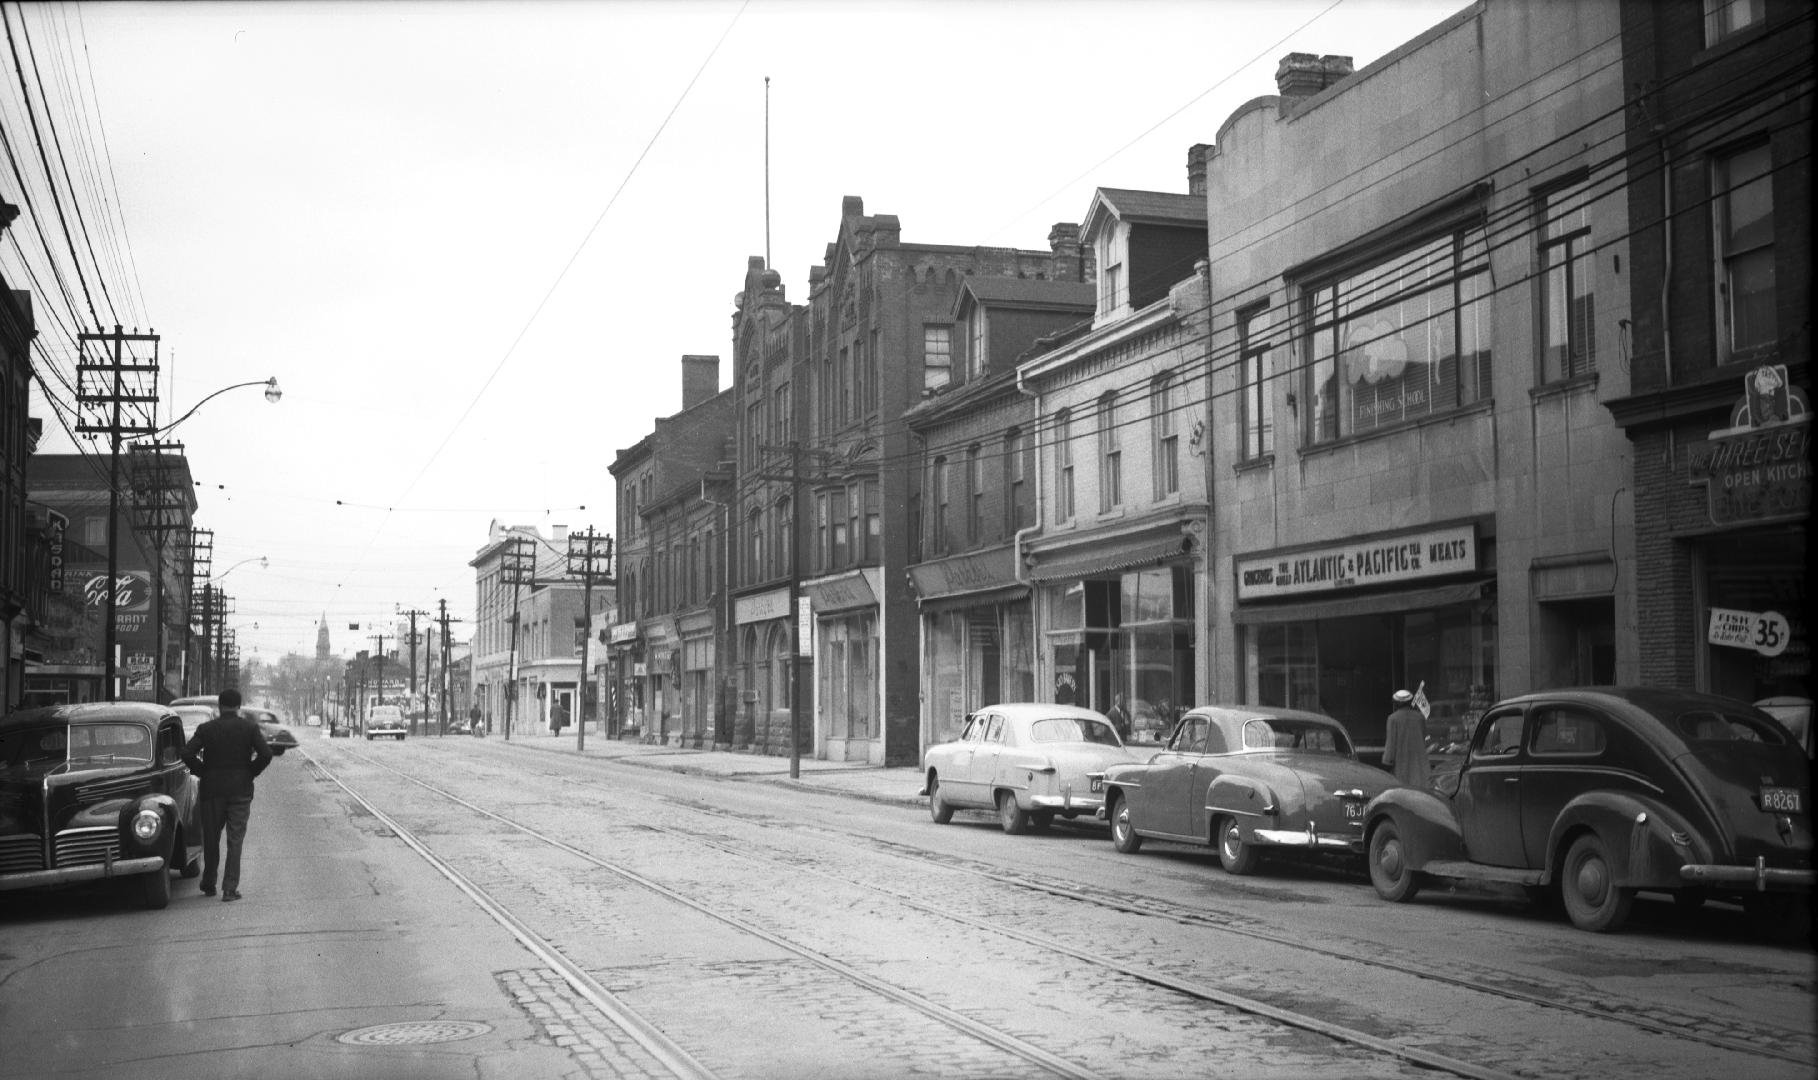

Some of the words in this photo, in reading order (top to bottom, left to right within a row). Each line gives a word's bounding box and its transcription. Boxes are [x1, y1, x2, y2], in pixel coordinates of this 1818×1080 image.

[1708, 437, 1769, 471] THREE
[1724, 469, 1760, 489] OPEN
[1293, 554, 1346, 585] ATLANTIC
[1347, 559, 1355, 573] &
[1356, 544, 1409, 577] PACIFIC
[1429, 539, 1466, 563] MEATS
[1718, 613, 1749, 625] FISH
[1722, 622, 1750, 634] CHIPS
